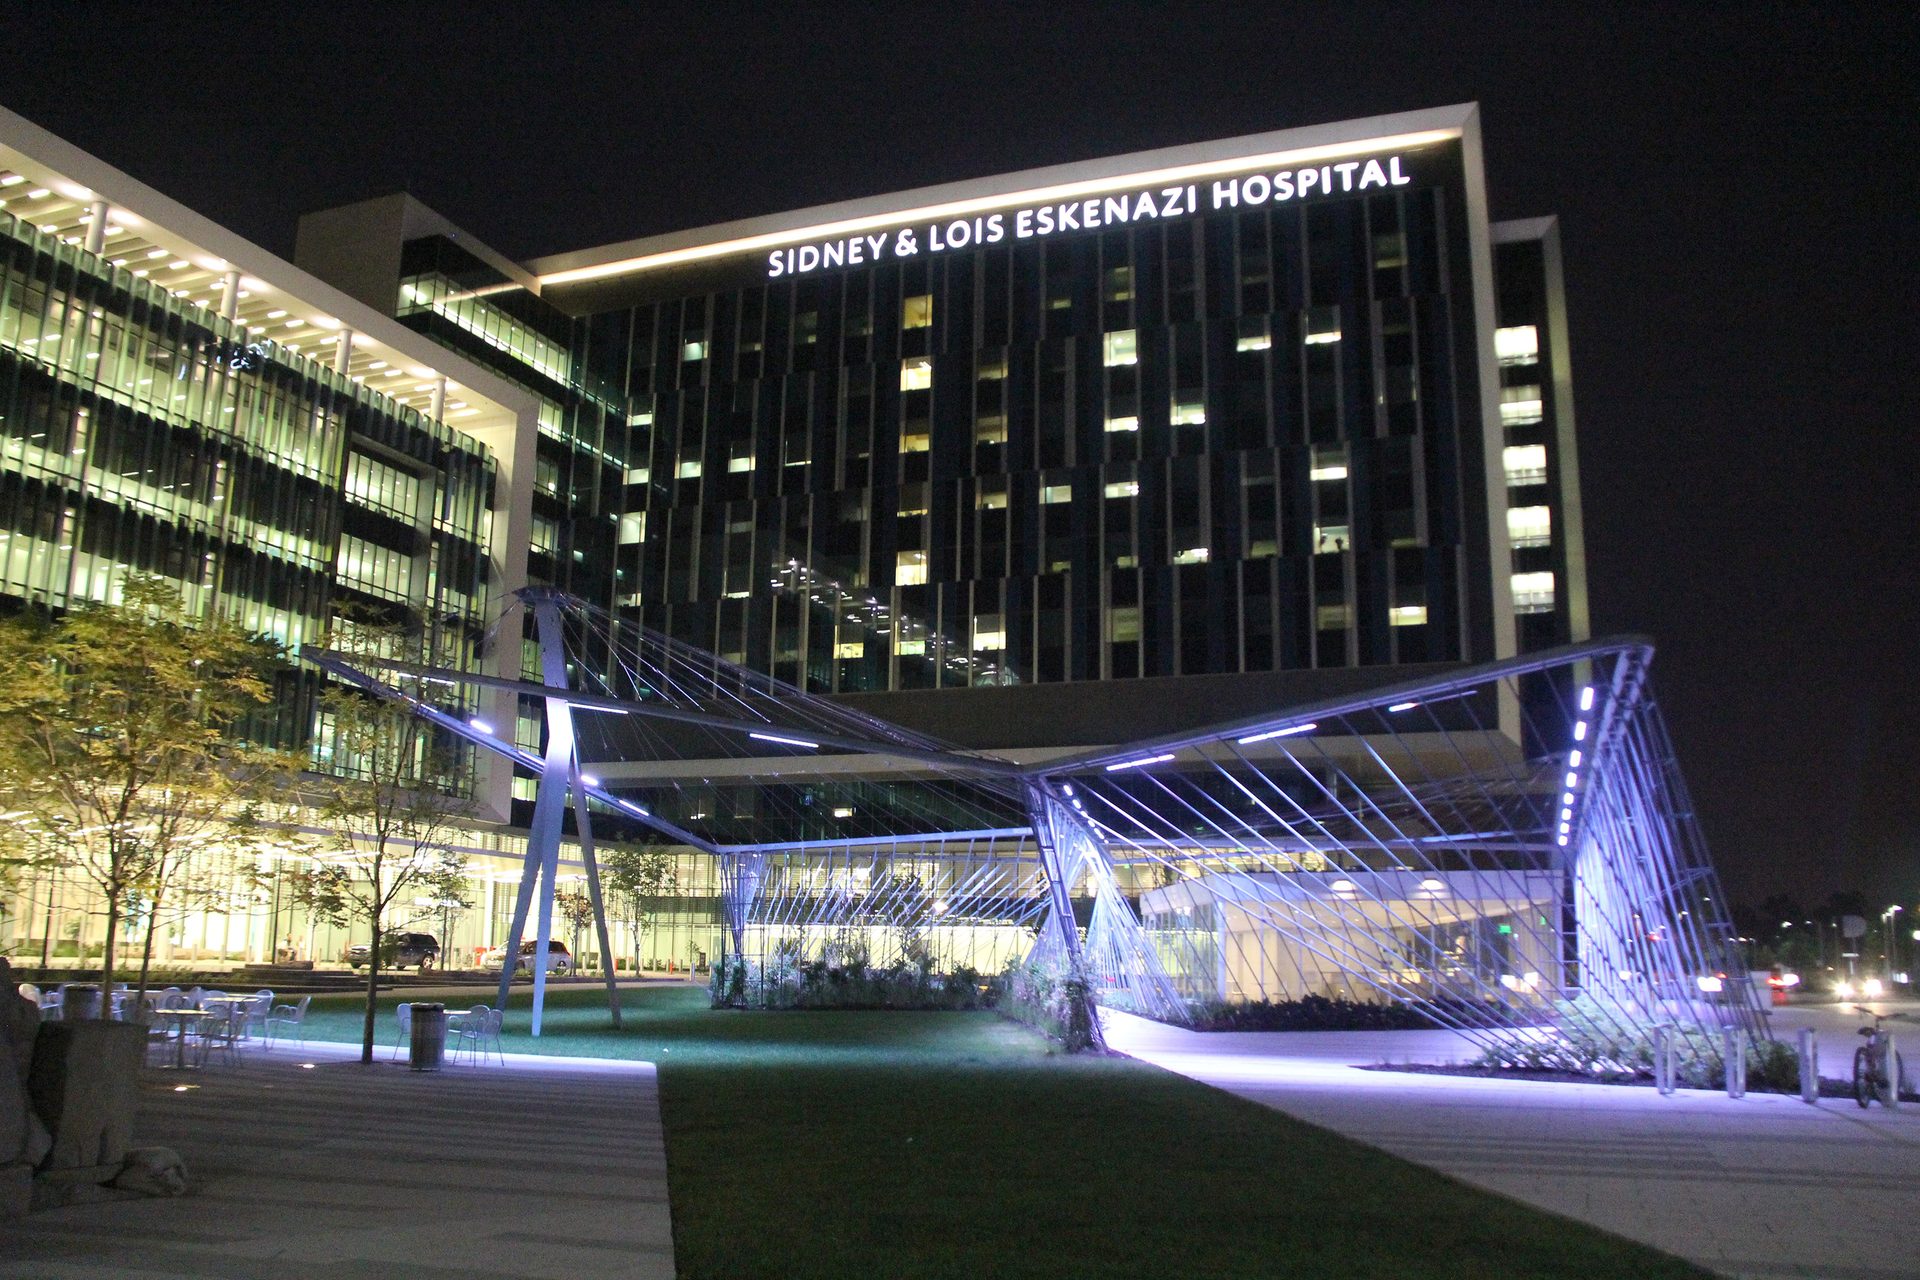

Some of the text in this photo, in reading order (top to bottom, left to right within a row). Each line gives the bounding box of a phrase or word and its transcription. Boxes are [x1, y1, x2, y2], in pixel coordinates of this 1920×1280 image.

[768, 156, 1411, 278] SIDNEY & LOIS ESKENAZI HOSPITAL
